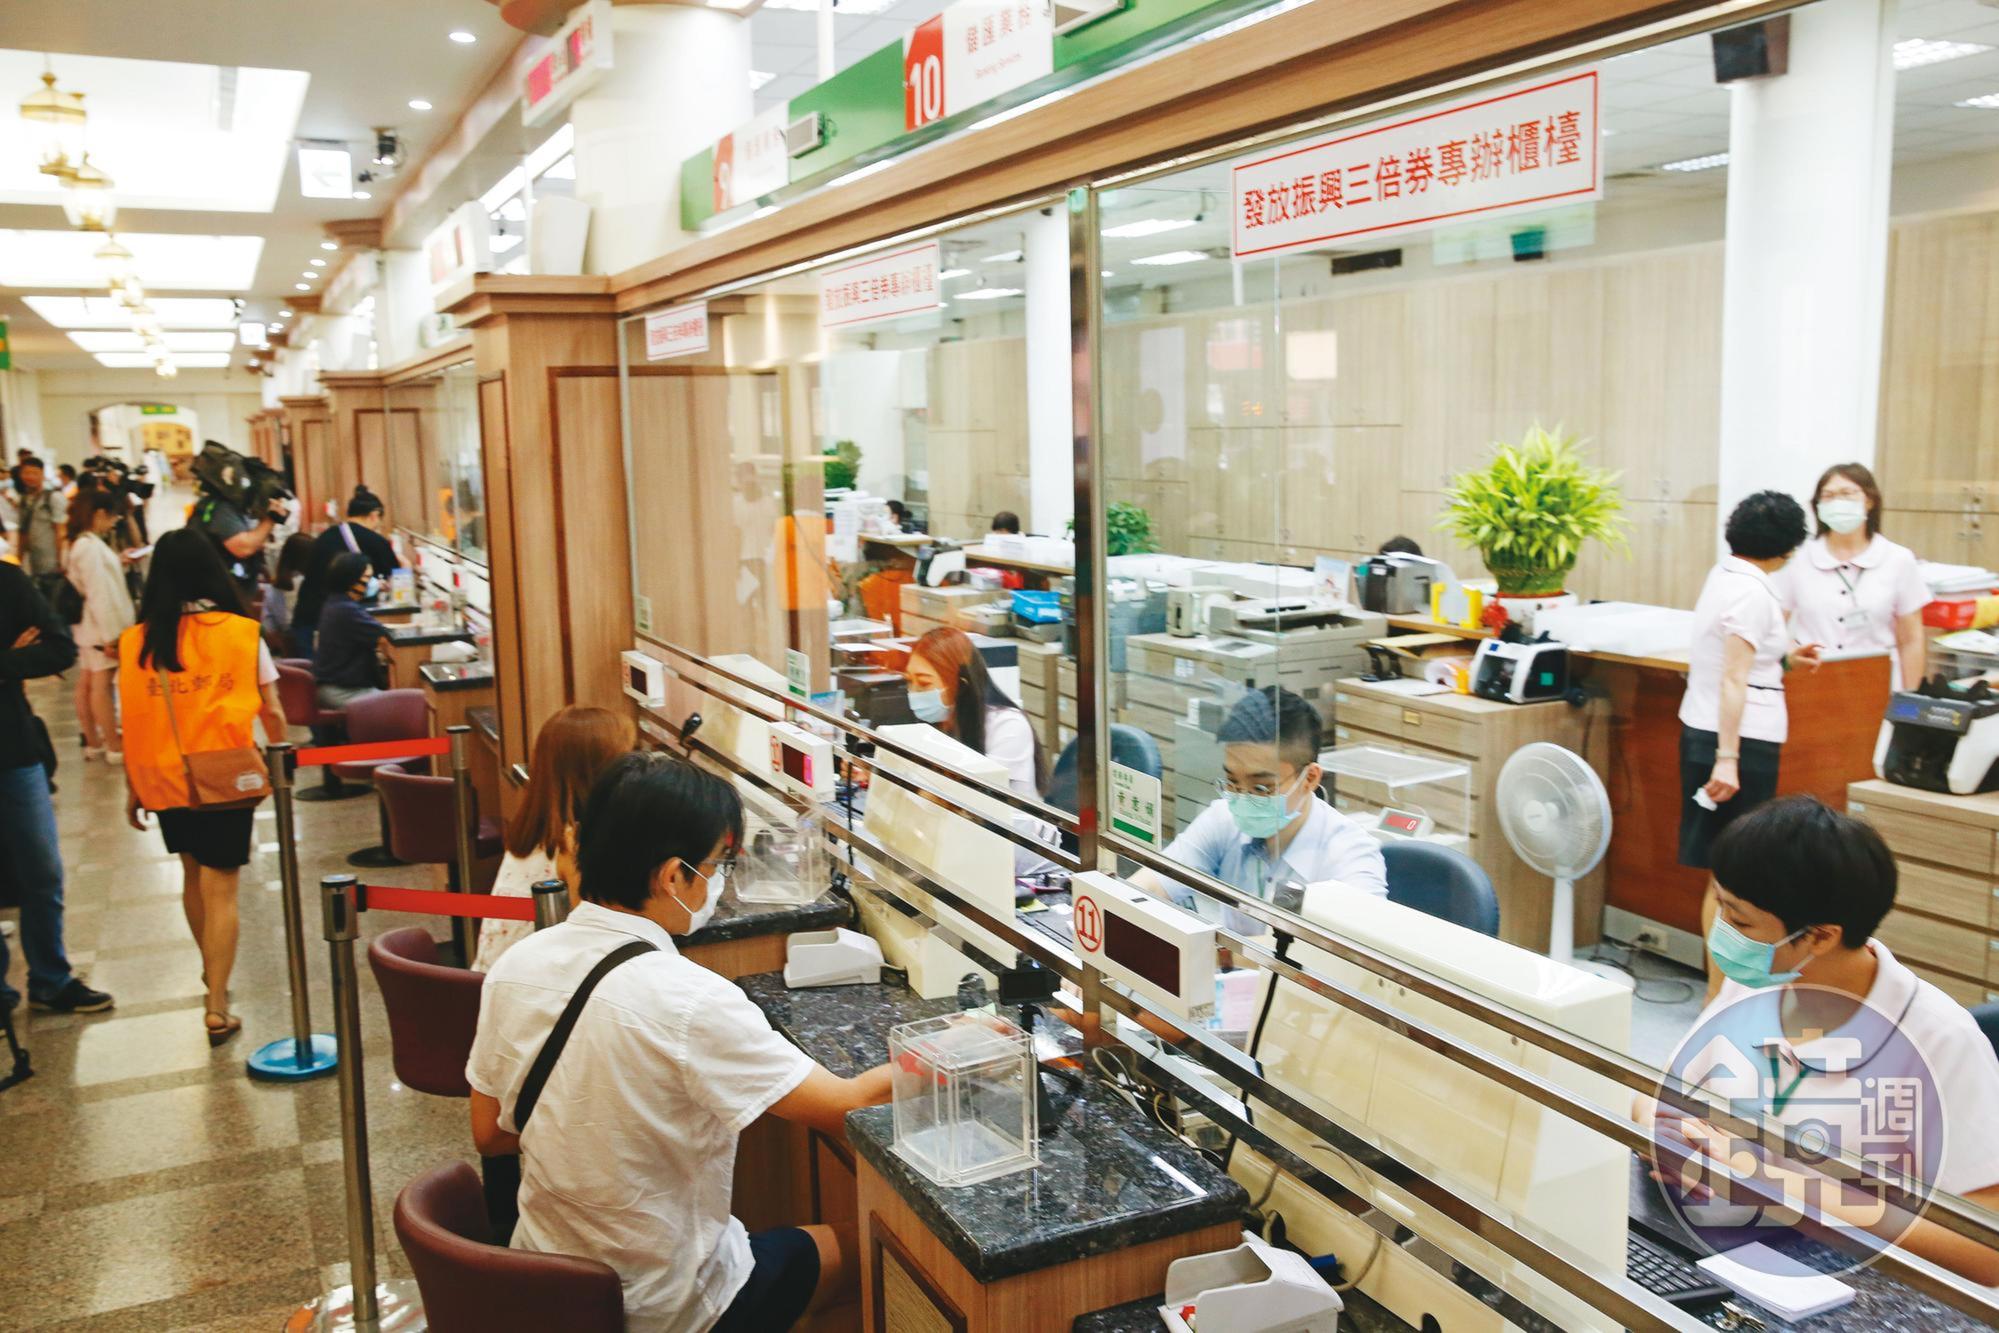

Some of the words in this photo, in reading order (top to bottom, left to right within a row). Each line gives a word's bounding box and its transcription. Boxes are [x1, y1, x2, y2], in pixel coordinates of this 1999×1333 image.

[909, 54, 942, 127] 10
[1243, 109, 1582, 230] 發放振興三倍券專辦櫃檯
[1406, 819, 1417, 830] 0
[1076, 903, 1100, 945] 11
